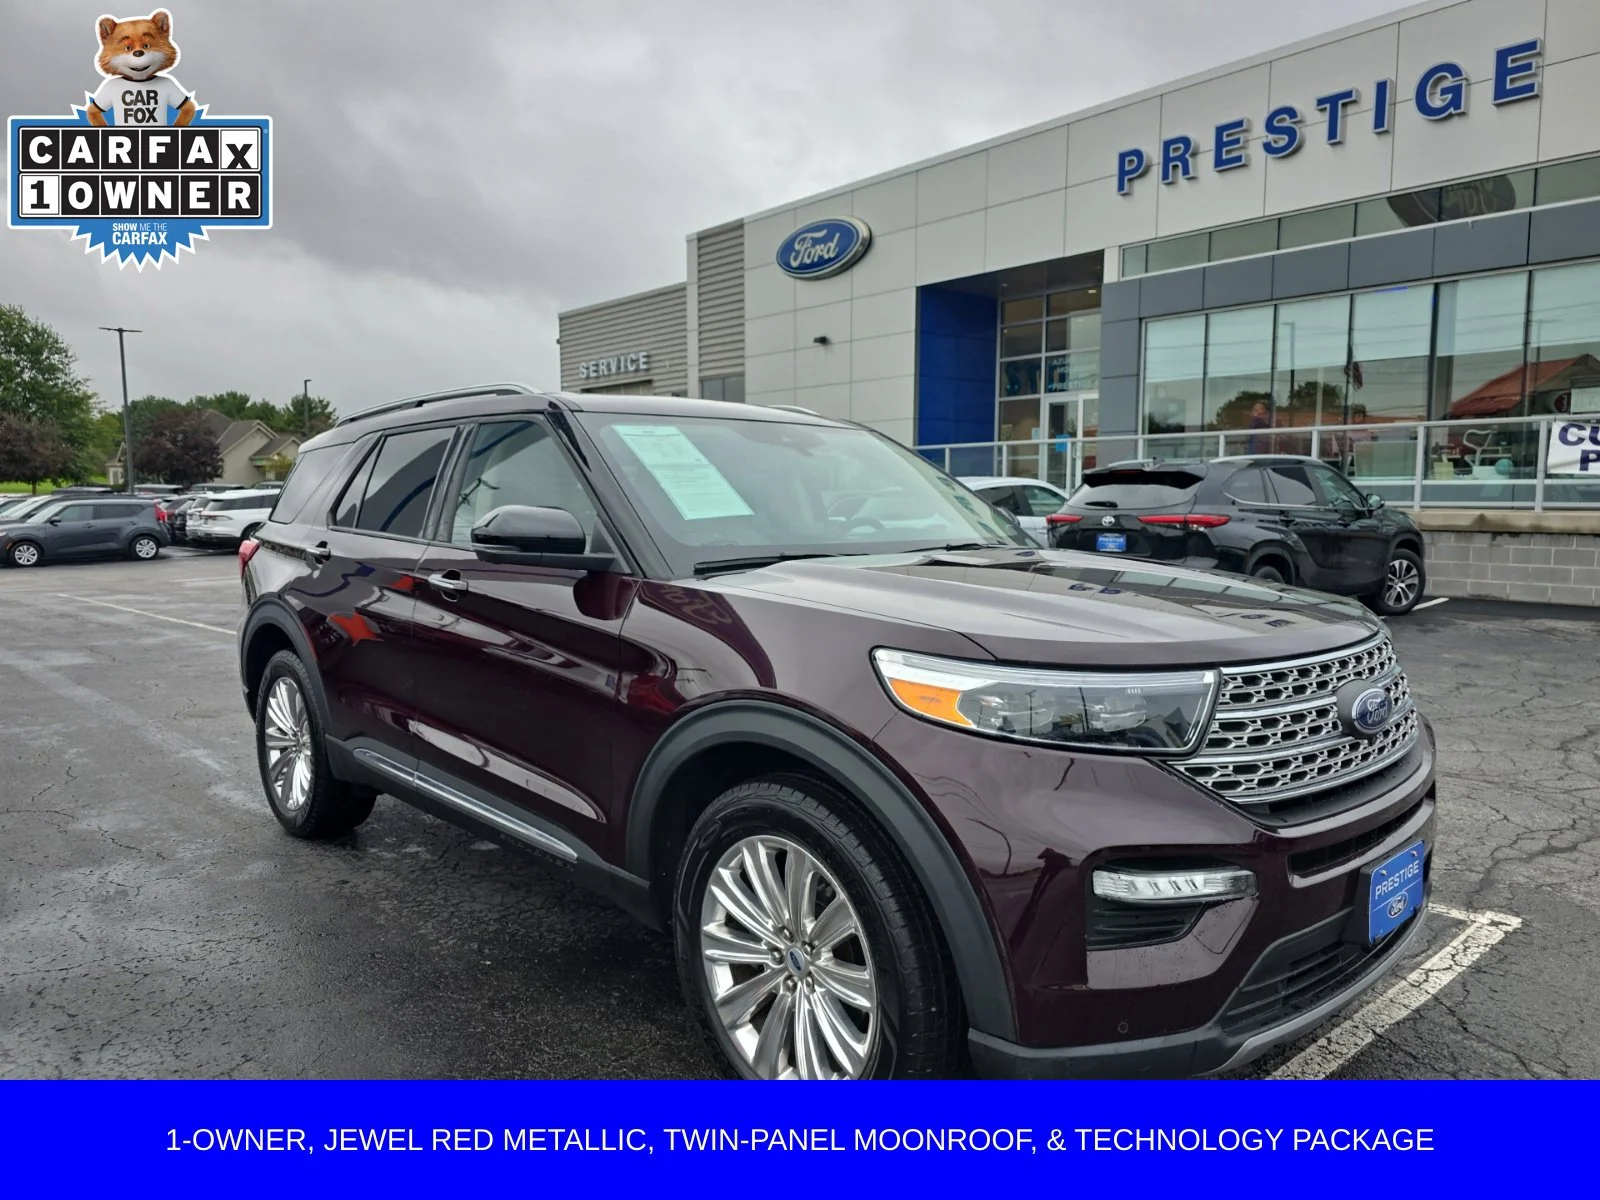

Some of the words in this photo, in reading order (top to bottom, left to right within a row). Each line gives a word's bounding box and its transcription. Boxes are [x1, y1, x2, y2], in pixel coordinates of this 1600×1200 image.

[1117, 38, 1542, 196] PRESTIGE
[789, 228, 841, 268] Ford
[579, 351, 649, 378] SERVICE
[1366, 697, 1389, 724] Ford
[1375, 859, 1420, 900] PRESTIGE
